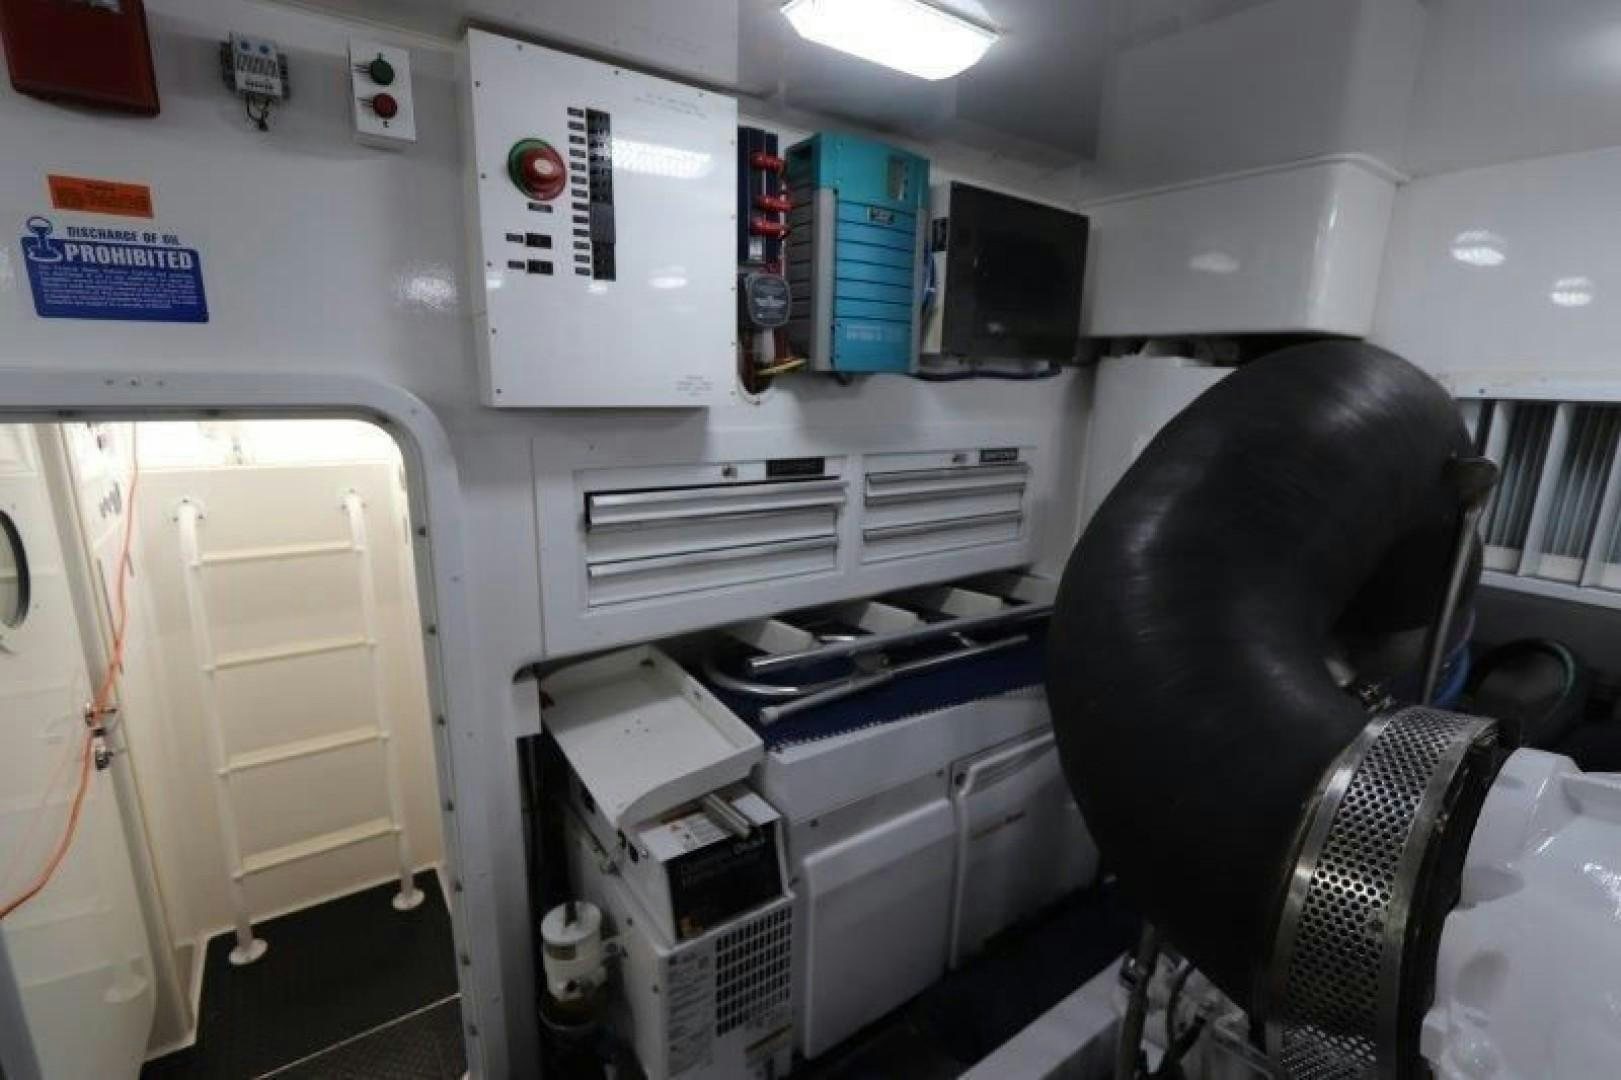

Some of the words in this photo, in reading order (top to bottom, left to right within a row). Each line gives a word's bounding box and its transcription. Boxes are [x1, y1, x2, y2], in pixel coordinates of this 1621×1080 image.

[66, 226, 137, 242] DISCHARGE
[143, 231, 157, 244] OF
[64, 242, 193, 270] PROHIBITED
